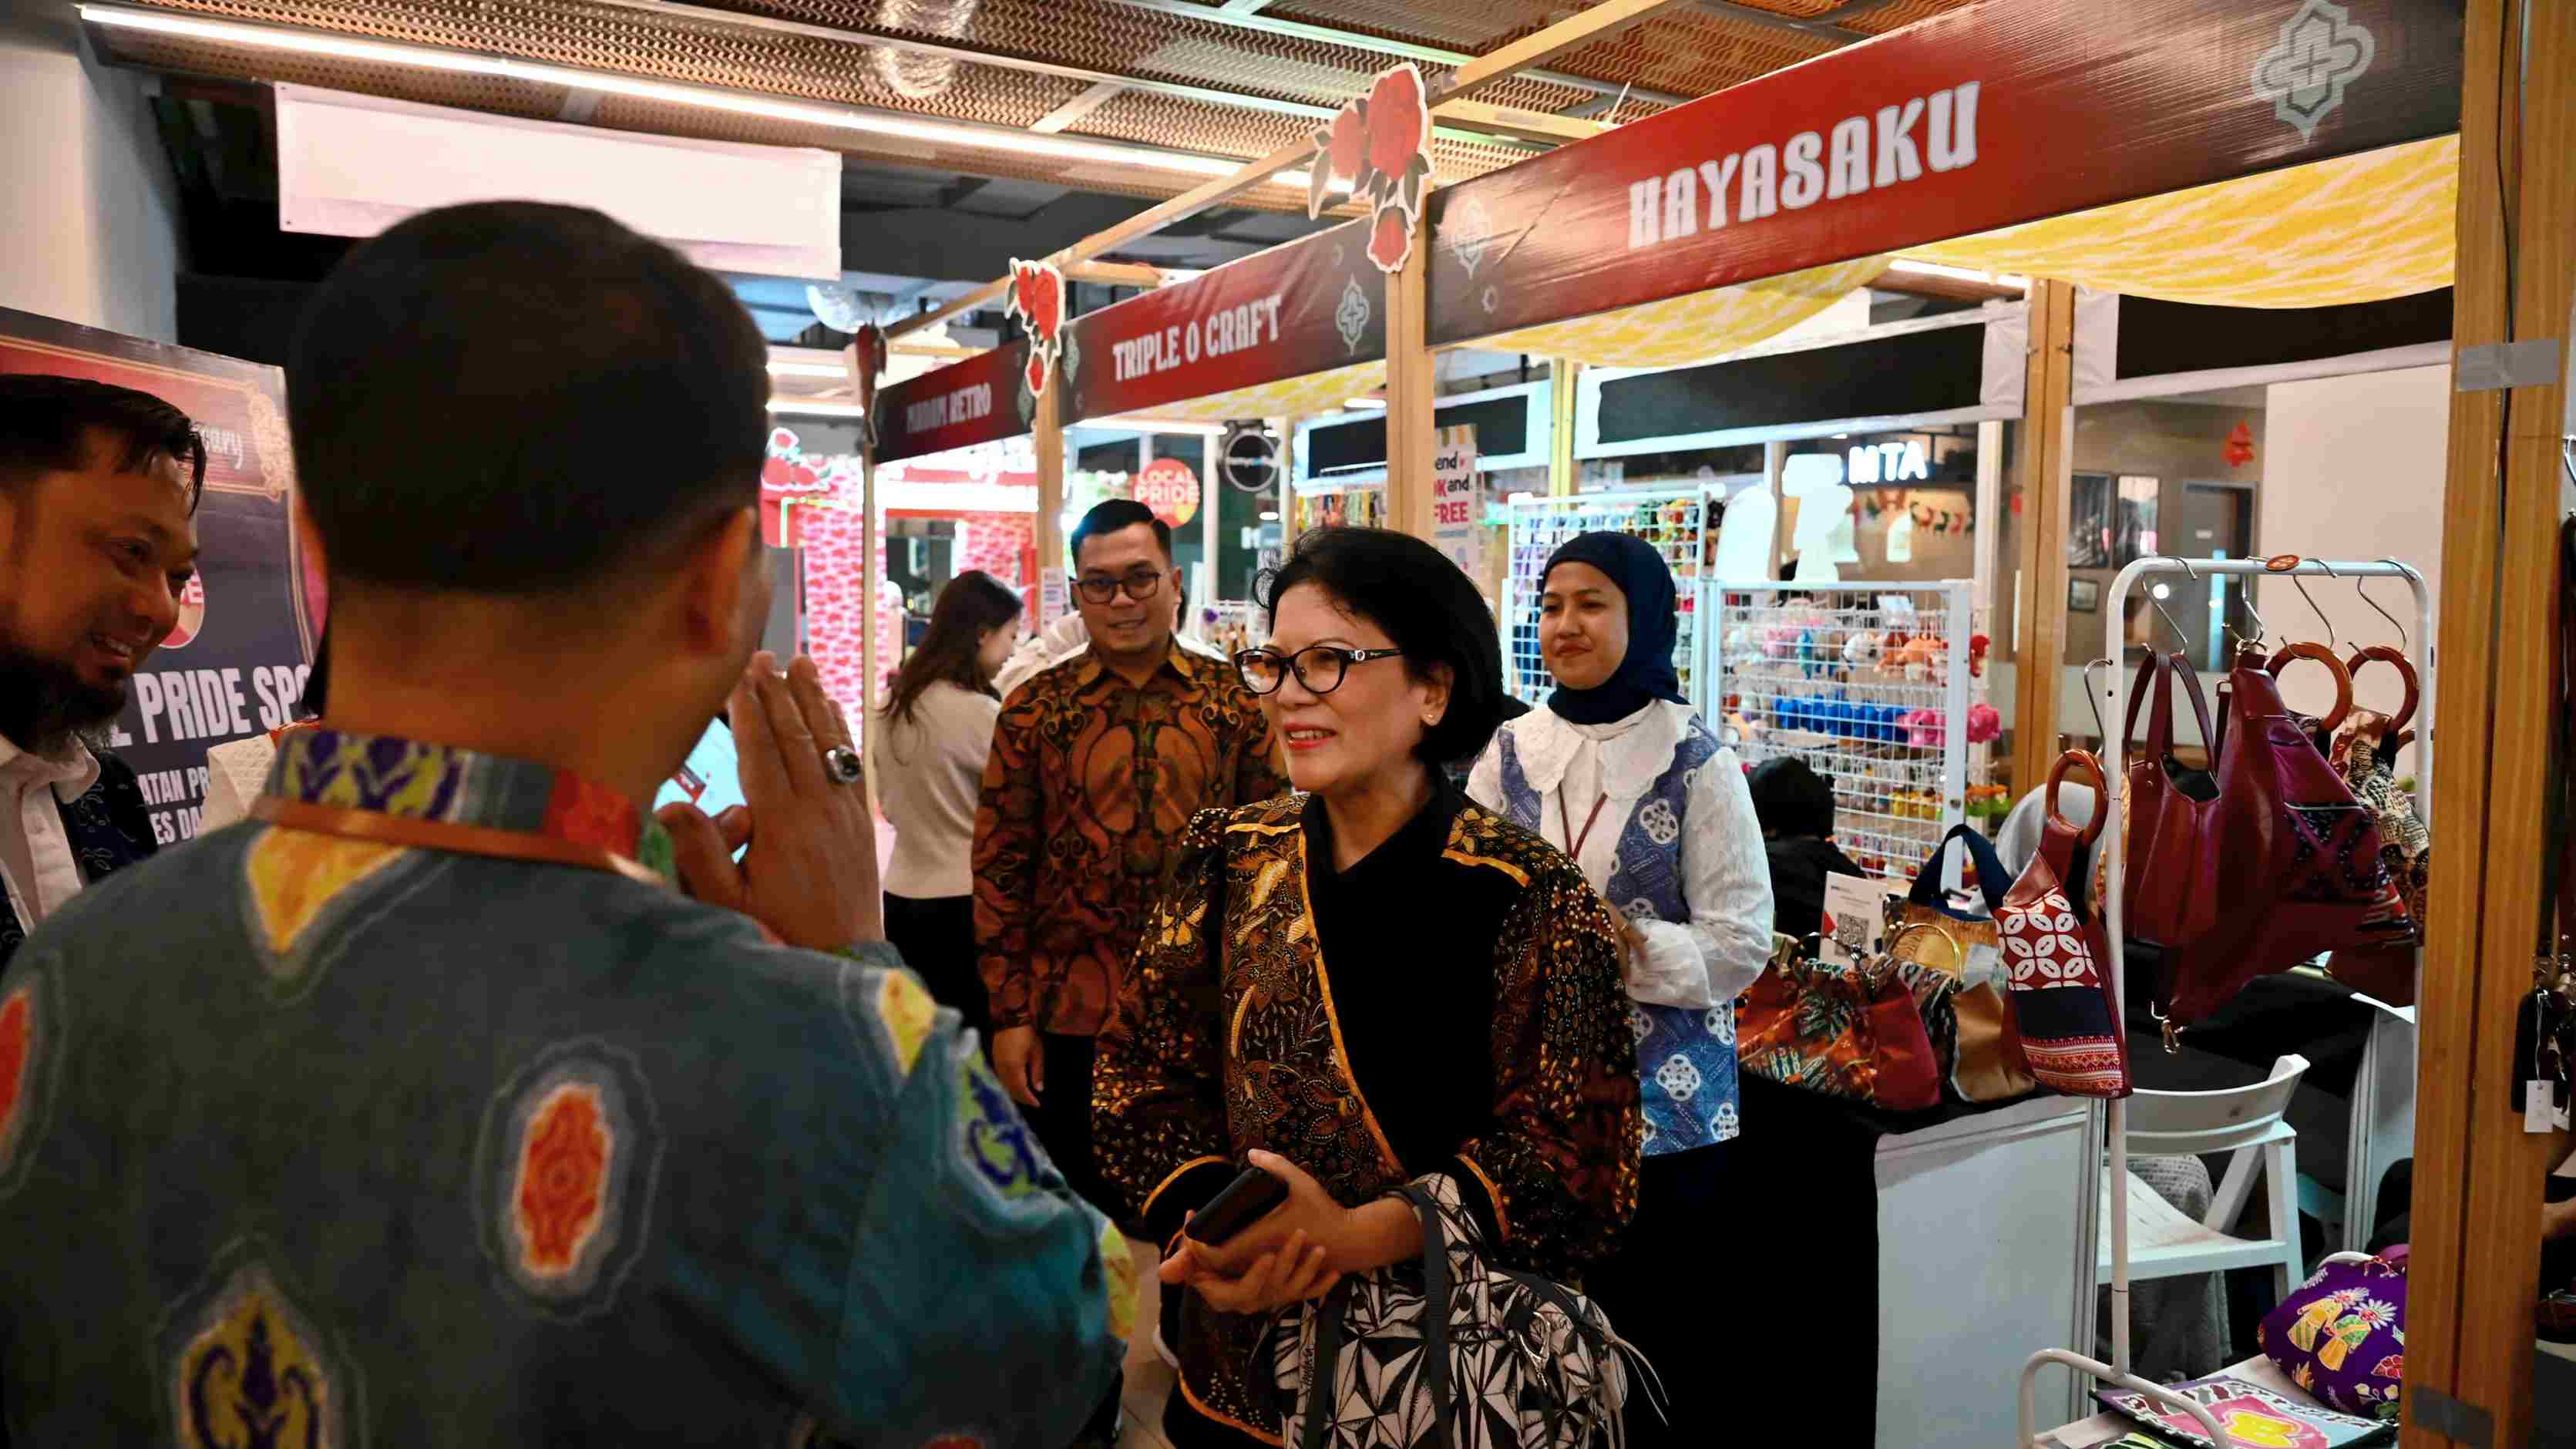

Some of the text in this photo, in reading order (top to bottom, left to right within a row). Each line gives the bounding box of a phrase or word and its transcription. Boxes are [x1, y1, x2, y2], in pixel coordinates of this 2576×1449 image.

[1628, 81, 1979, 250] HAYASAKU
[1112, 294, 1283, 382] TRIPLE O CRAFT
[1848, 440, 1928, 484] MTA
[133, 667, 252, 743] PRIDE
